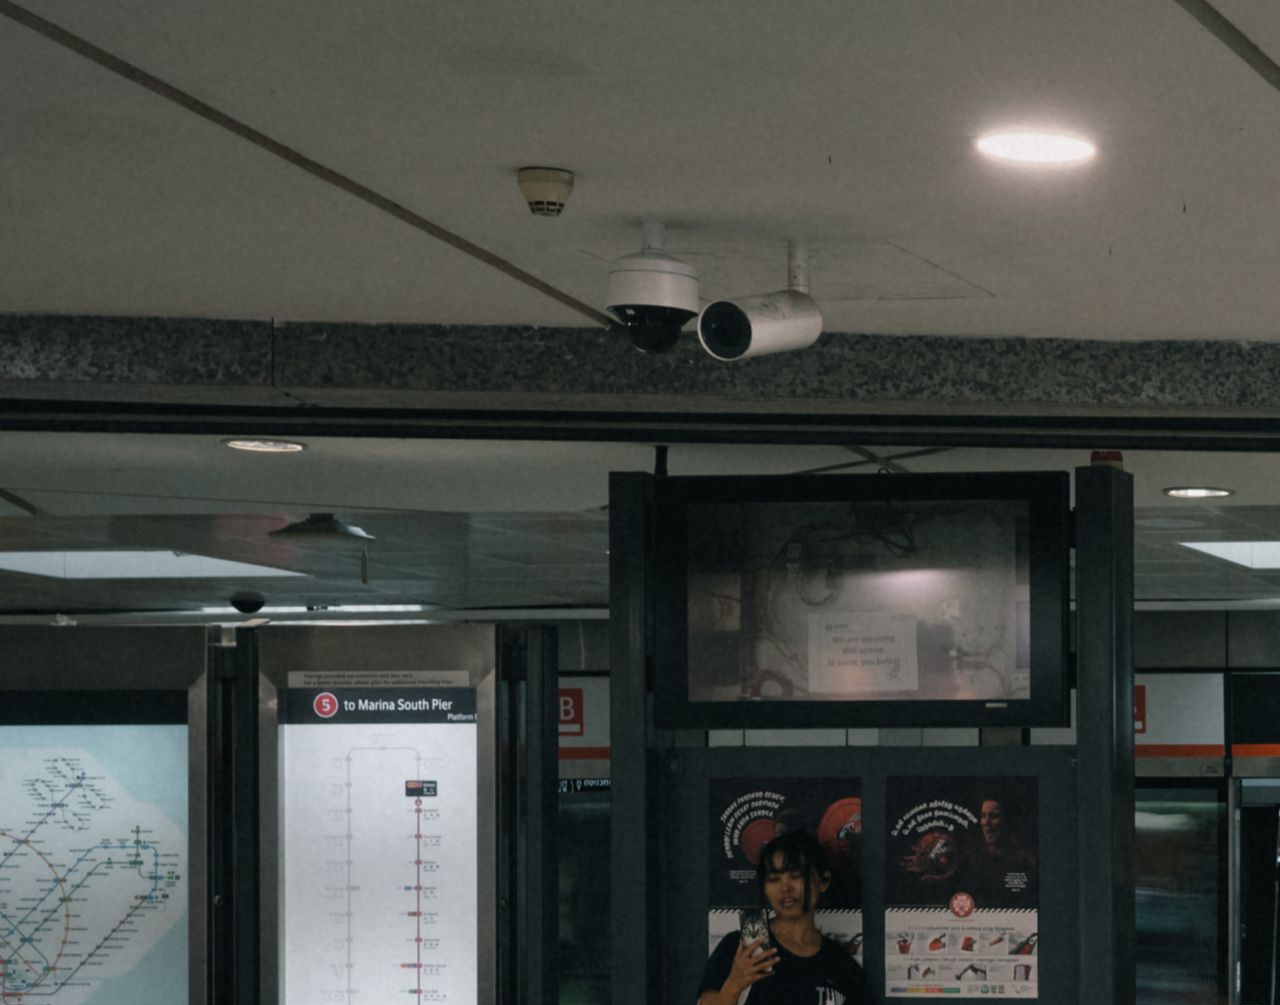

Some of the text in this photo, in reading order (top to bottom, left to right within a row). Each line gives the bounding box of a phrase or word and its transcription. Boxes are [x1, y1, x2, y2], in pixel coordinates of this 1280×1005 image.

[322, 700, 330, 711] 5
[344, 699, 453, 711] to Marina South Pier
[560, 696, 575, 720] B
[447, 713, 474, 721] Platform
